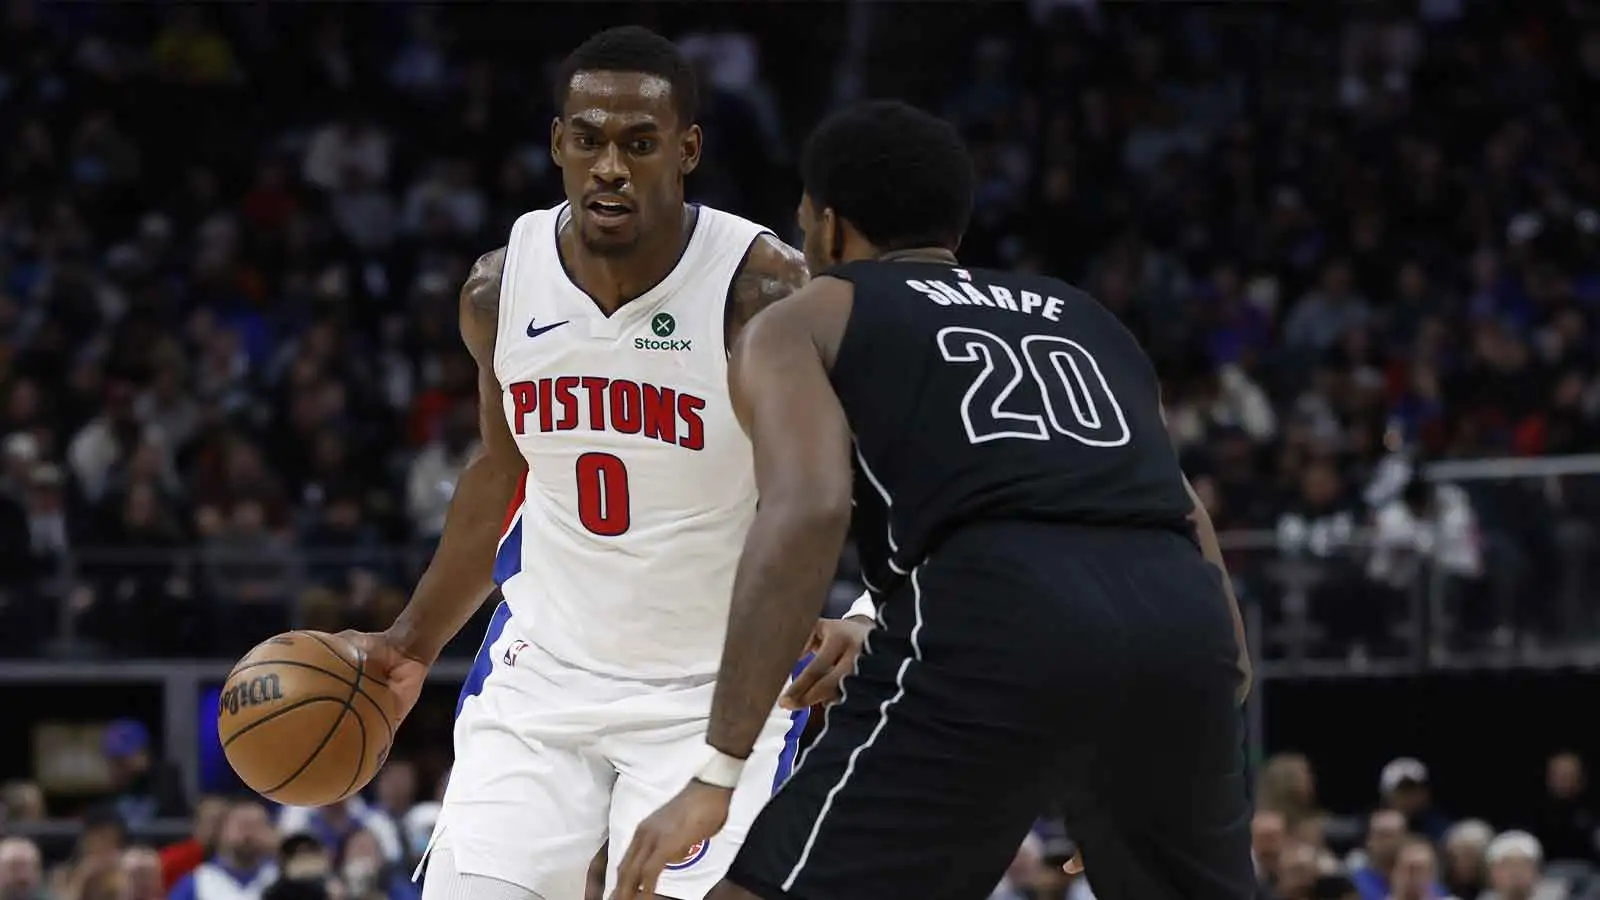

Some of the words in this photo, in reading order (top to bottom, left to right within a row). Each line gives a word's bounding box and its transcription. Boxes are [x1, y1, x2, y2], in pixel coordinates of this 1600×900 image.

[906, 279, 1065, 322] SHARPE
[634, 337, 692, 351] StockX
[510, 376, 706, 451] PISTONS
[937, 326, 1131, 447] 20
[576, 452, 630, 536] 0
